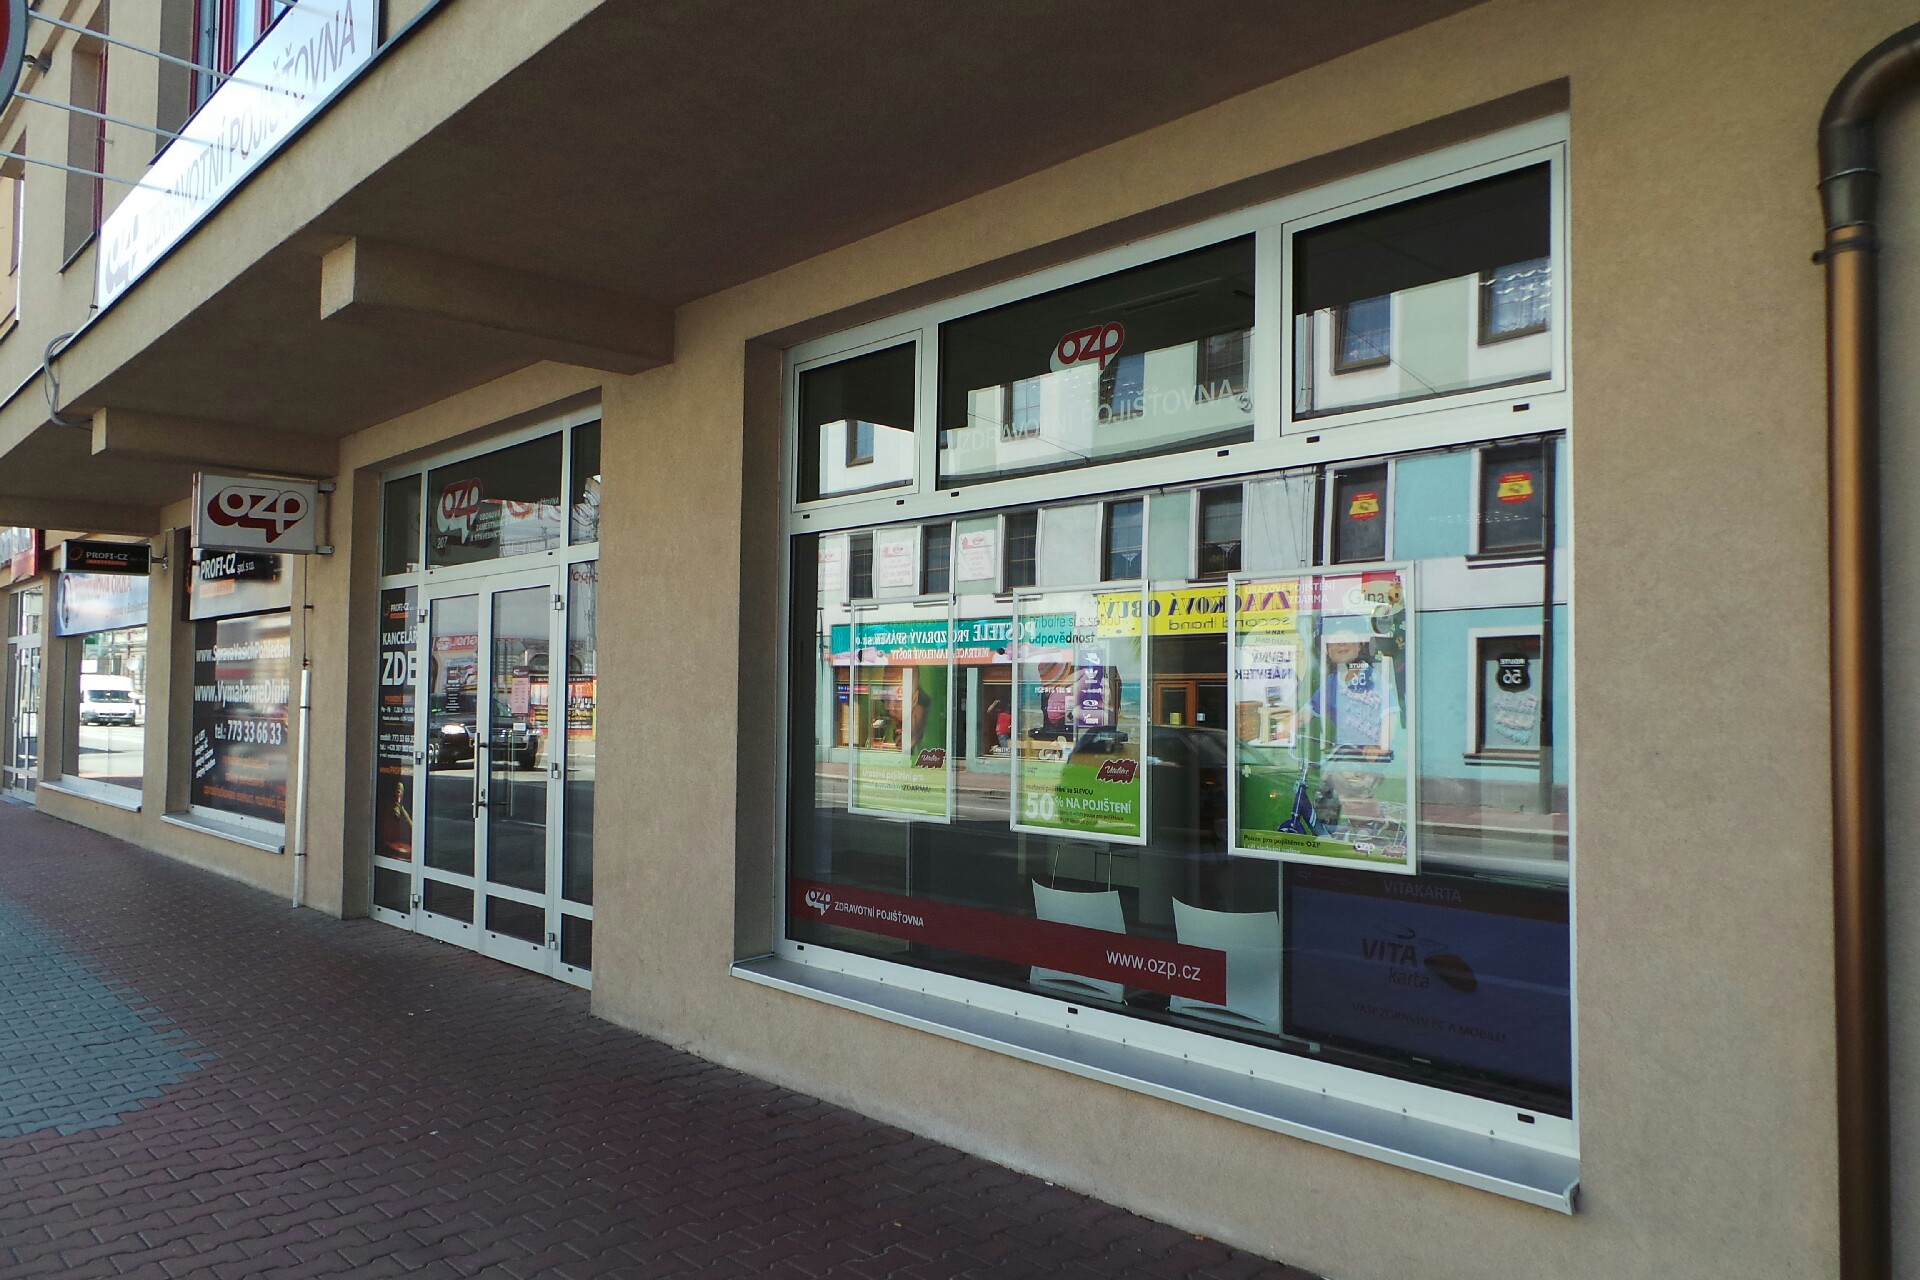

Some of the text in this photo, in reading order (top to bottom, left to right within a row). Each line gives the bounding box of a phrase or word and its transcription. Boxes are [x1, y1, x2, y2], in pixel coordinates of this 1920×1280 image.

[86, 551, 129, 560] PROFI-CZ
[200, 553, 236, 580] PROFI-CZ
[1289, 595, 1329, 604] ZDARMA
[1349, 588, 1386, 605] Gina
[1029, 631, 1096, 647] odpovědnost
[382, 651, 417, 686] ZDE
[228, 720, 242, 742] 773
[244, 720, 255, 743] 33
[257, 721, 268, 744] 66
[270, 722, 282, 745] 33
[1025, 792, 1054, 821] 50
[1066, 798, 1081, 809] NA
[1243, 834, 1262, 843] Pouze
[1383, 879, 1463, 903] VITAKARTA
[834, 899, 876, 919] ZDRAVOTNÍ
[875, 906, 925, 928] POJIŠŤOVNA
[1106, 948, 1202, 982] www.ozp.cz
[1361, 938, 1418, 968] VITA
[1389, 966, 1430, 990] karta
